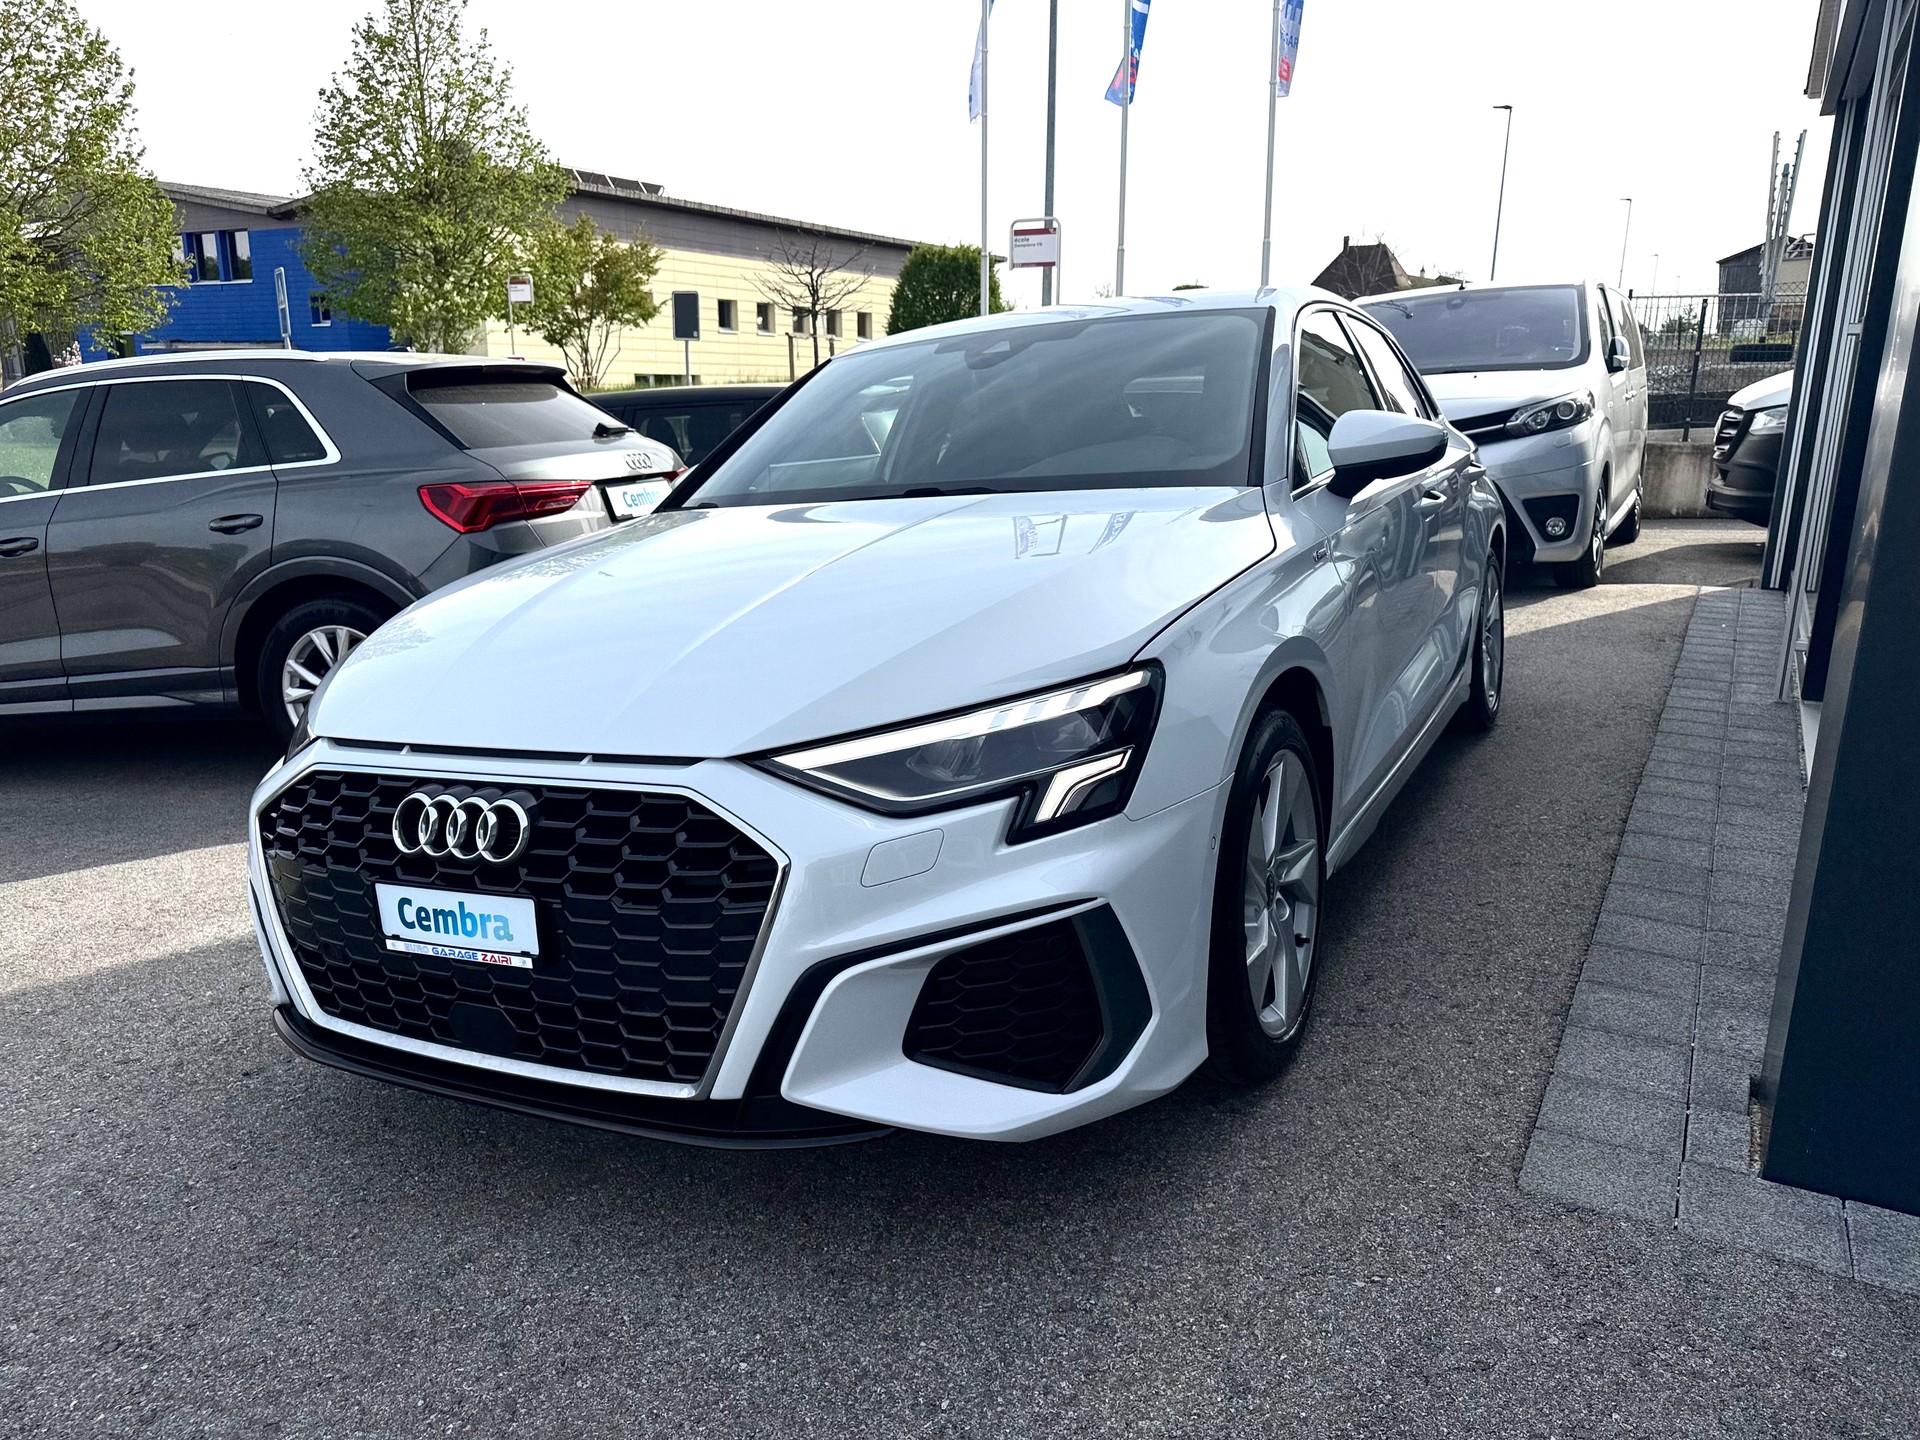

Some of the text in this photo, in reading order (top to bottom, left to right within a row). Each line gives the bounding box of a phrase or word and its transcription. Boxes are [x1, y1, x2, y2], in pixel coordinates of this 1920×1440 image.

[397, 897, 514, 942] Cembra
[431, 947, 479, 961] GARAGE
[481, 953, 512, 965] ZAIRI
